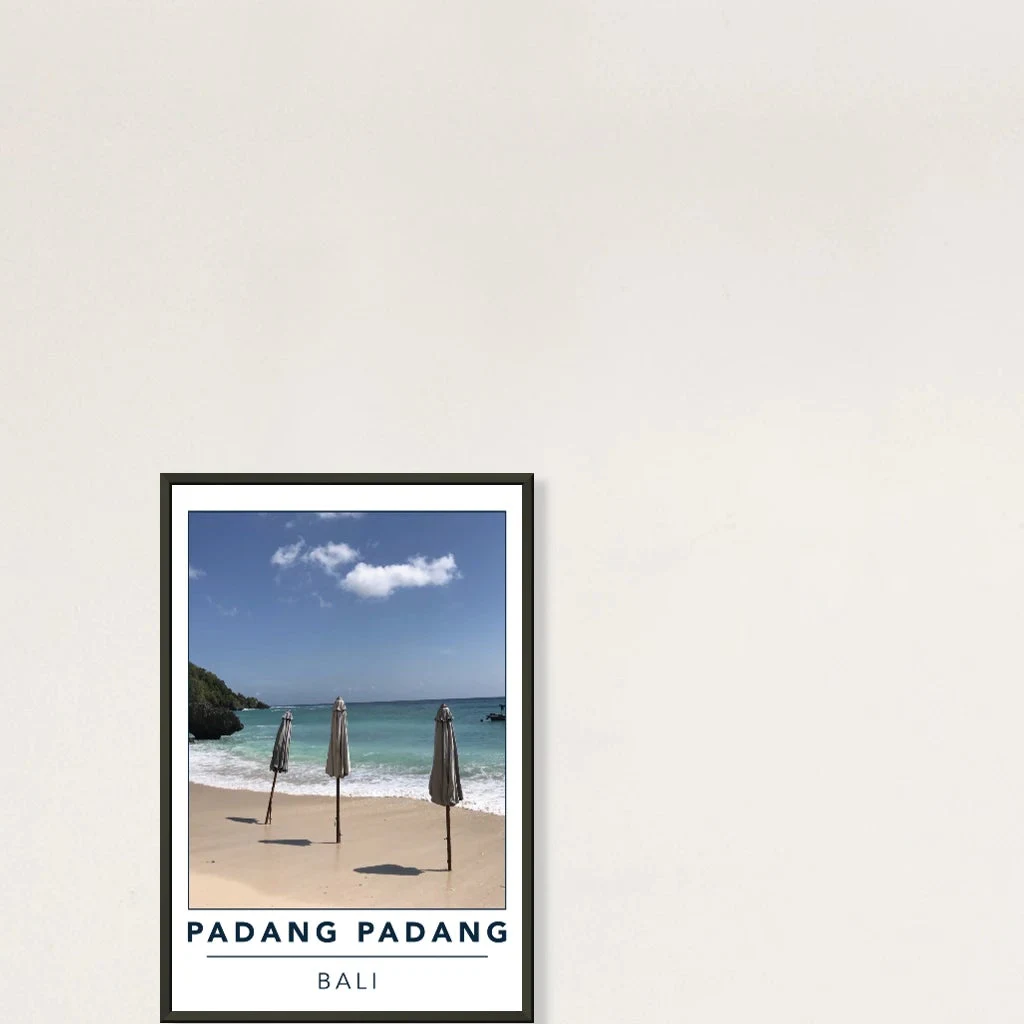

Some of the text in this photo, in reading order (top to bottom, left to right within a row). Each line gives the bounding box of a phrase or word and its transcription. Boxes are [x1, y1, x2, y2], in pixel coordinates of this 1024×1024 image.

[187, 920, 508, 944] PADANG PADANG
[318, 971, 377, 990] BALI
